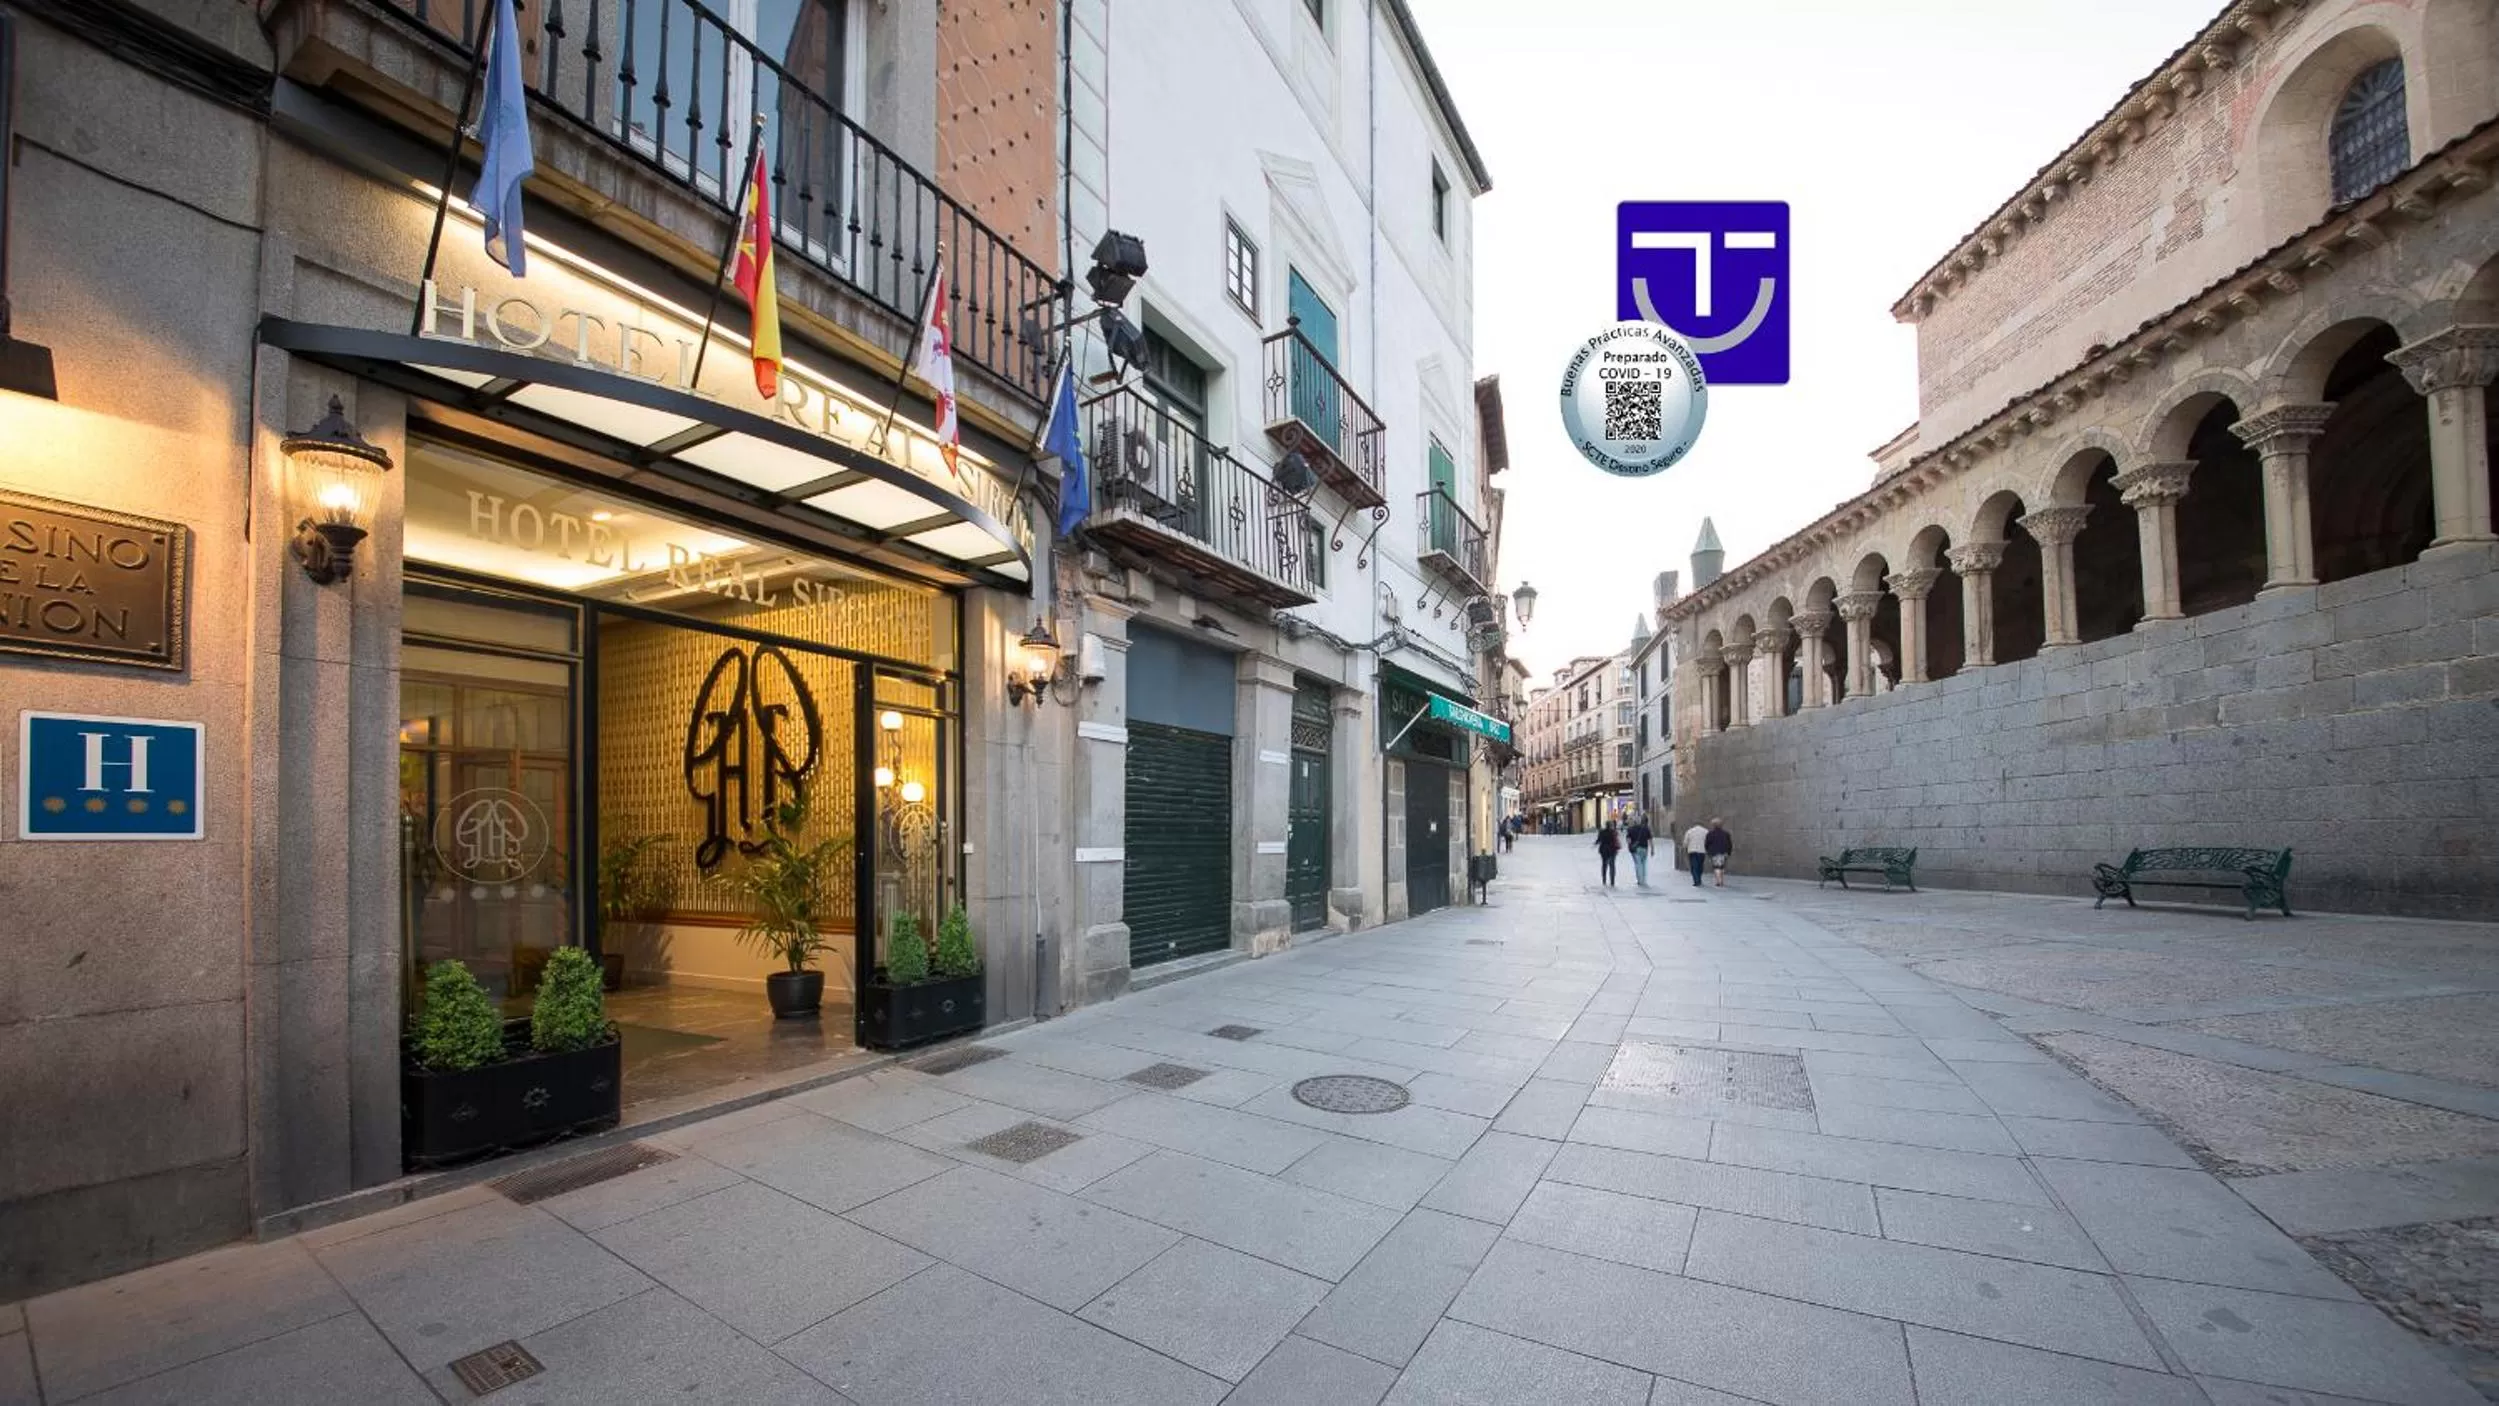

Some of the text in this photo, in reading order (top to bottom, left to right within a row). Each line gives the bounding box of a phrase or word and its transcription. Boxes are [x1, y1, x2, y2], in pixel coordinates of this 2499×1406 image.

[419, 278, 723, 397] HOTEL
[771, 372, 929, 477] REAL
[35, 563, 96, 596] LA
[465, 489, 646, 573] HOTEL
[665, 542, 777, 608] REAL
[77, 731, 157, 793] H
